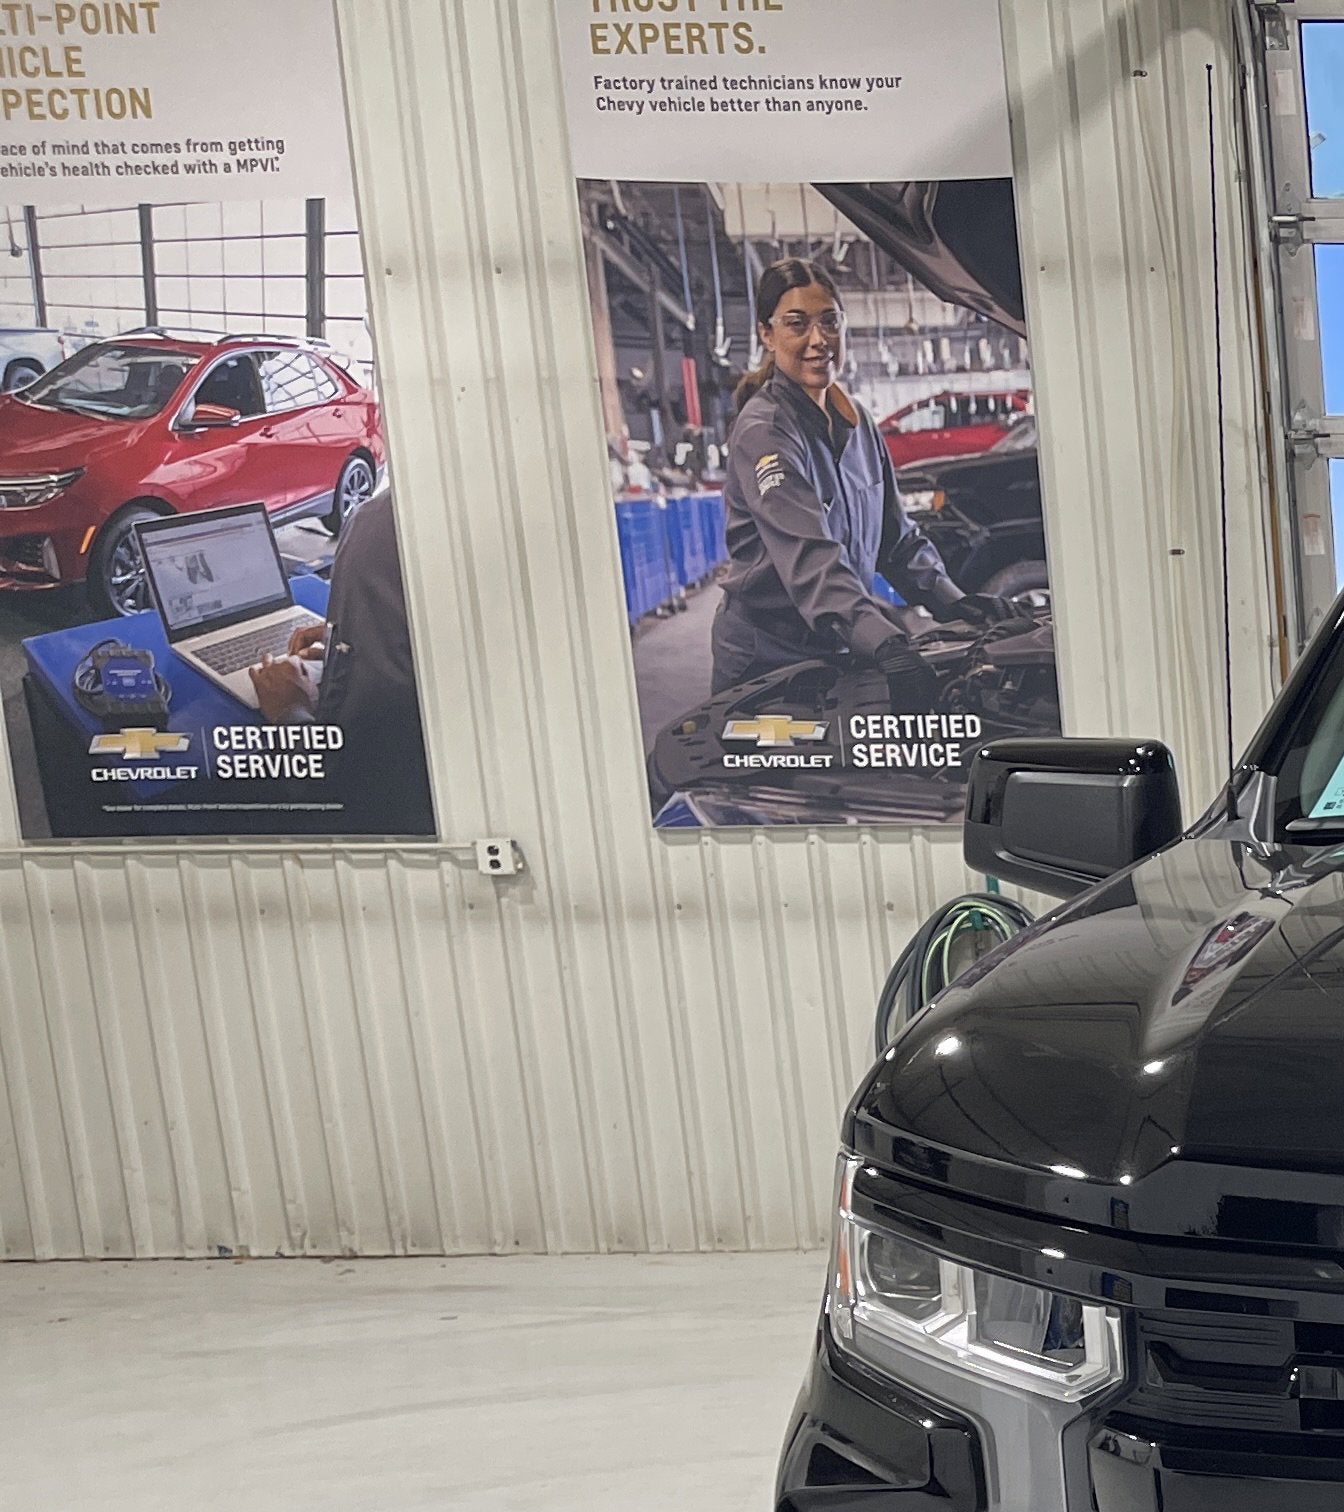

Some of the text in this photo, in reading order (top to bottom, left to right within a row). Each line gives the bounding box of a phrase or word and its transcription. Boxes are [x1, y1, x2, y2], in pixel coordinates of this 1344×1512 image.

[590, 22, 766, 55] EXPERTS.
[594, 74, 903, 94] Factory trained technicians know your
[596, 96, 868, 116] Chevy vehicle better than anyone.
[32, 141, 46, 155] of
[52, 141, 90, 155] mind
[94, 140, 127, 155] that
[131, 142, 181, 154] comes
[186, 138, 223, 153] from
[228, 137, 285, 156] getting
[61, 161, 111, 176] health
[115, 160, 180, 175] checked
[184, 159, 218, 174] with
[223, 163, 232, 173] a
[850, 713, 983, 740] CERTIFIED
[213, 725, 345, 751] CERTIFIED
[723, 753, 834, 769] CHEVROLET
[852, 742, 963, 769] SERVICE
[90, 765, 199, 782] CHEVROLET
[216, 753, 326, 780] SERVICE
